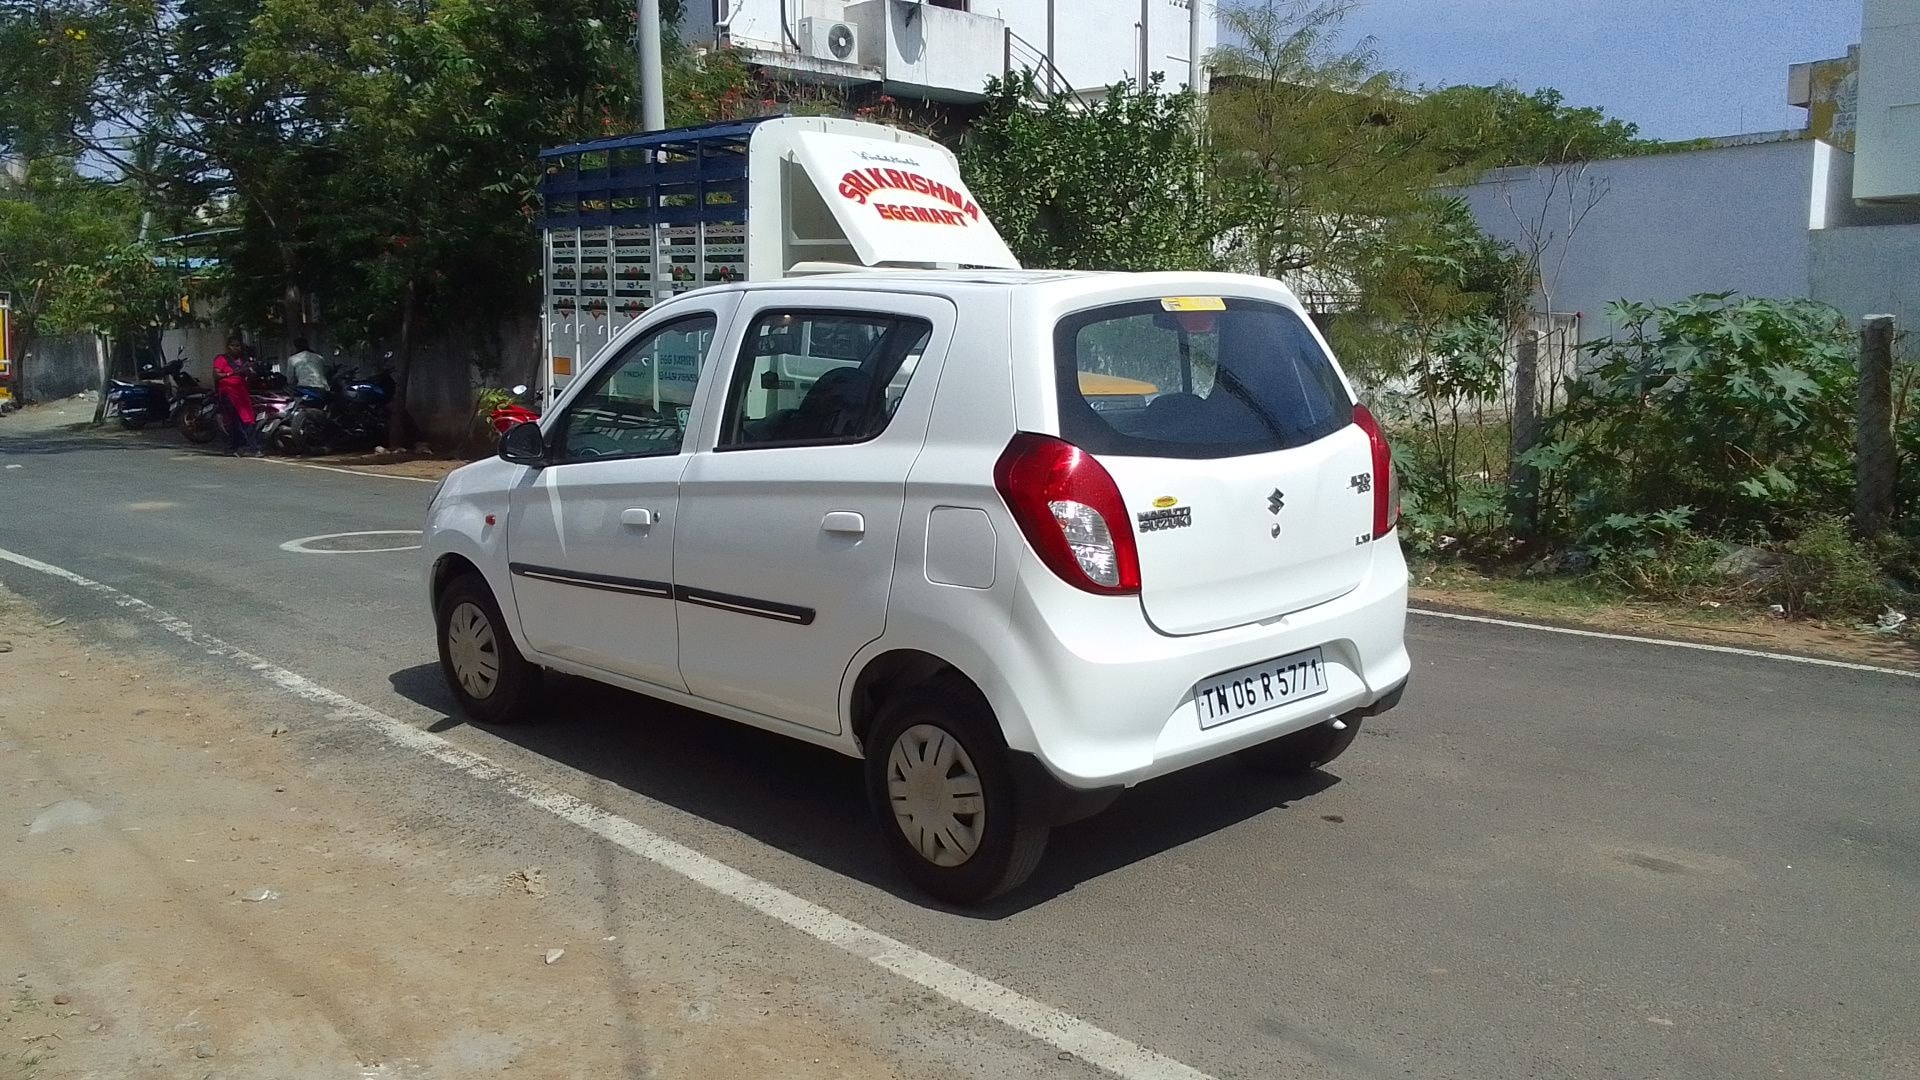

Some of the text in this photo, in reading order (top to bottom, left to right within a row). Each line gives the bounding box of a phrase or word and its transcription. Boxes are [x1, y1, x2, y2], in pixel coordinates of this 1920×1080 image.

[873, 202, 968, 227] EGGMART
[1139, 515, 1192, 533] SUZUKI
[1203, 658, 1320, 719] TN 06 R 5771
